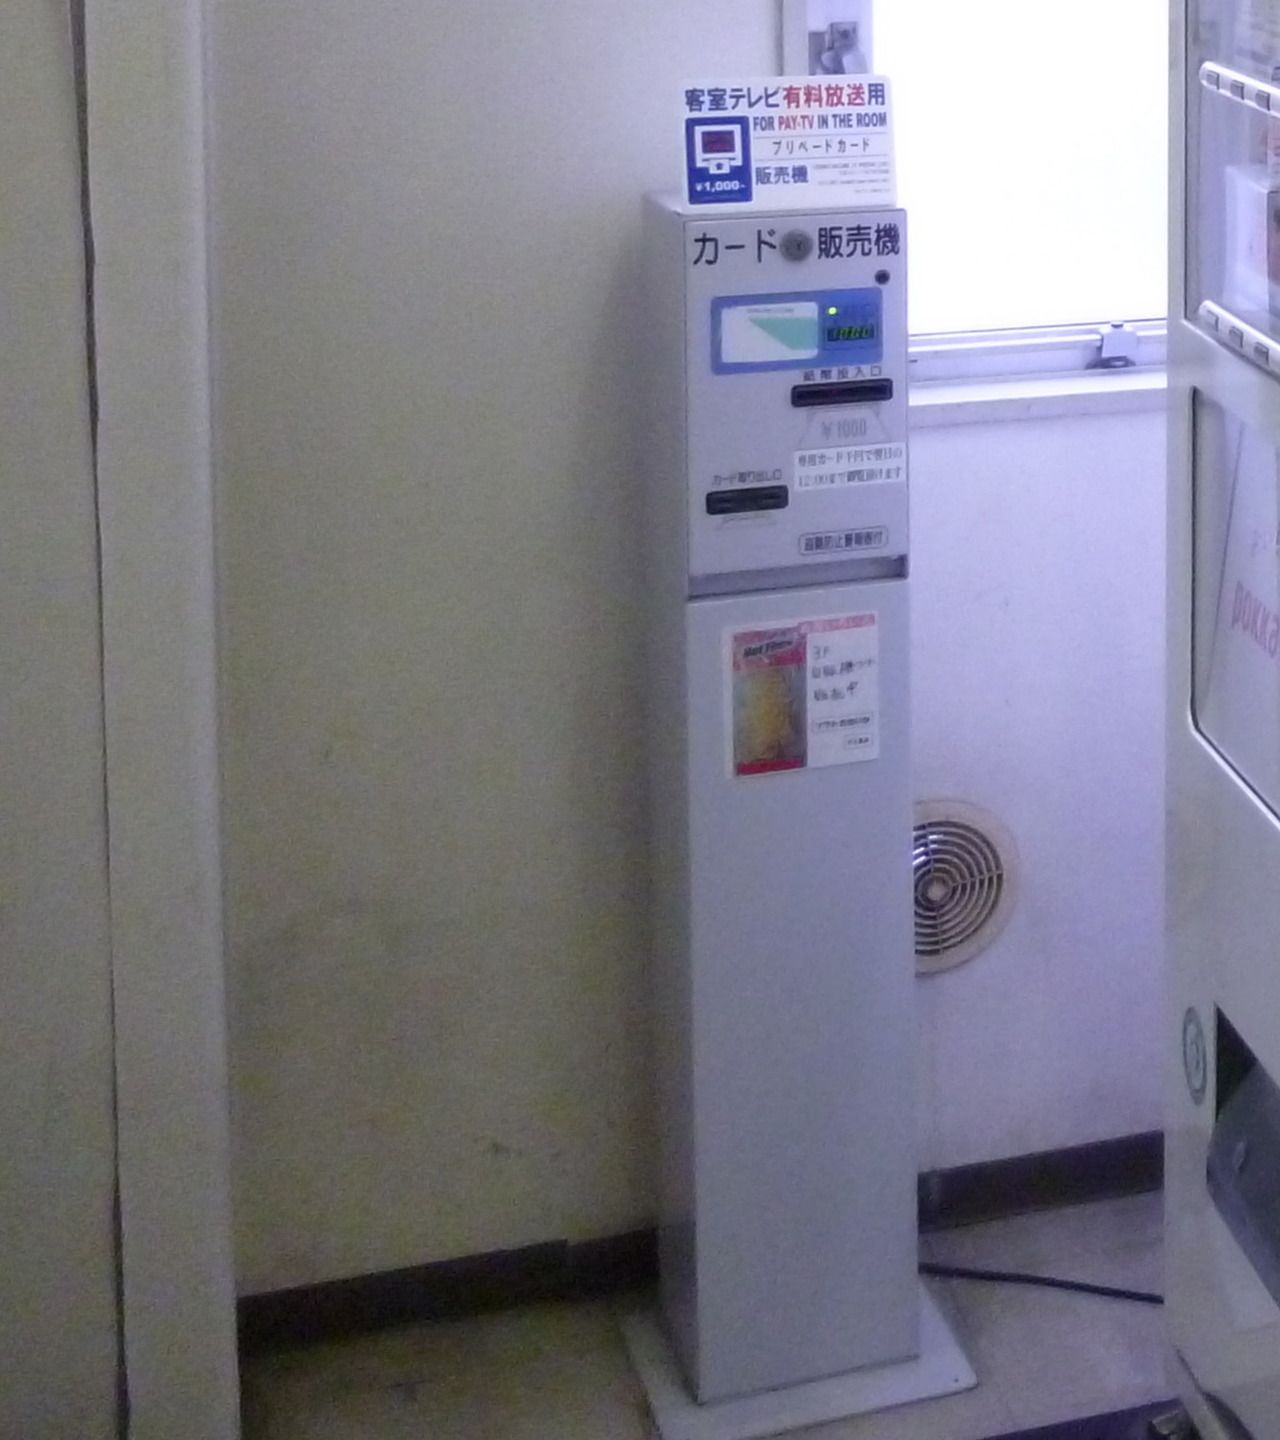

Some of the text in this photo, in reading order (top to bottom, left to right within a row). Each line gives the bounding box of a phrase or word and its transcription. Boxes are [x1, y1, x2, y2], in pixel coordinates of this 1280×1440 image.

[684, 83, 886, 112] 客室テレビ有料放送用
[753, 111, 887, 132] FOR PAY-TV IN THE ROOM
[755, 165, 809, 185] 販売機
[693, 223, 901, 266] カード 販売機
